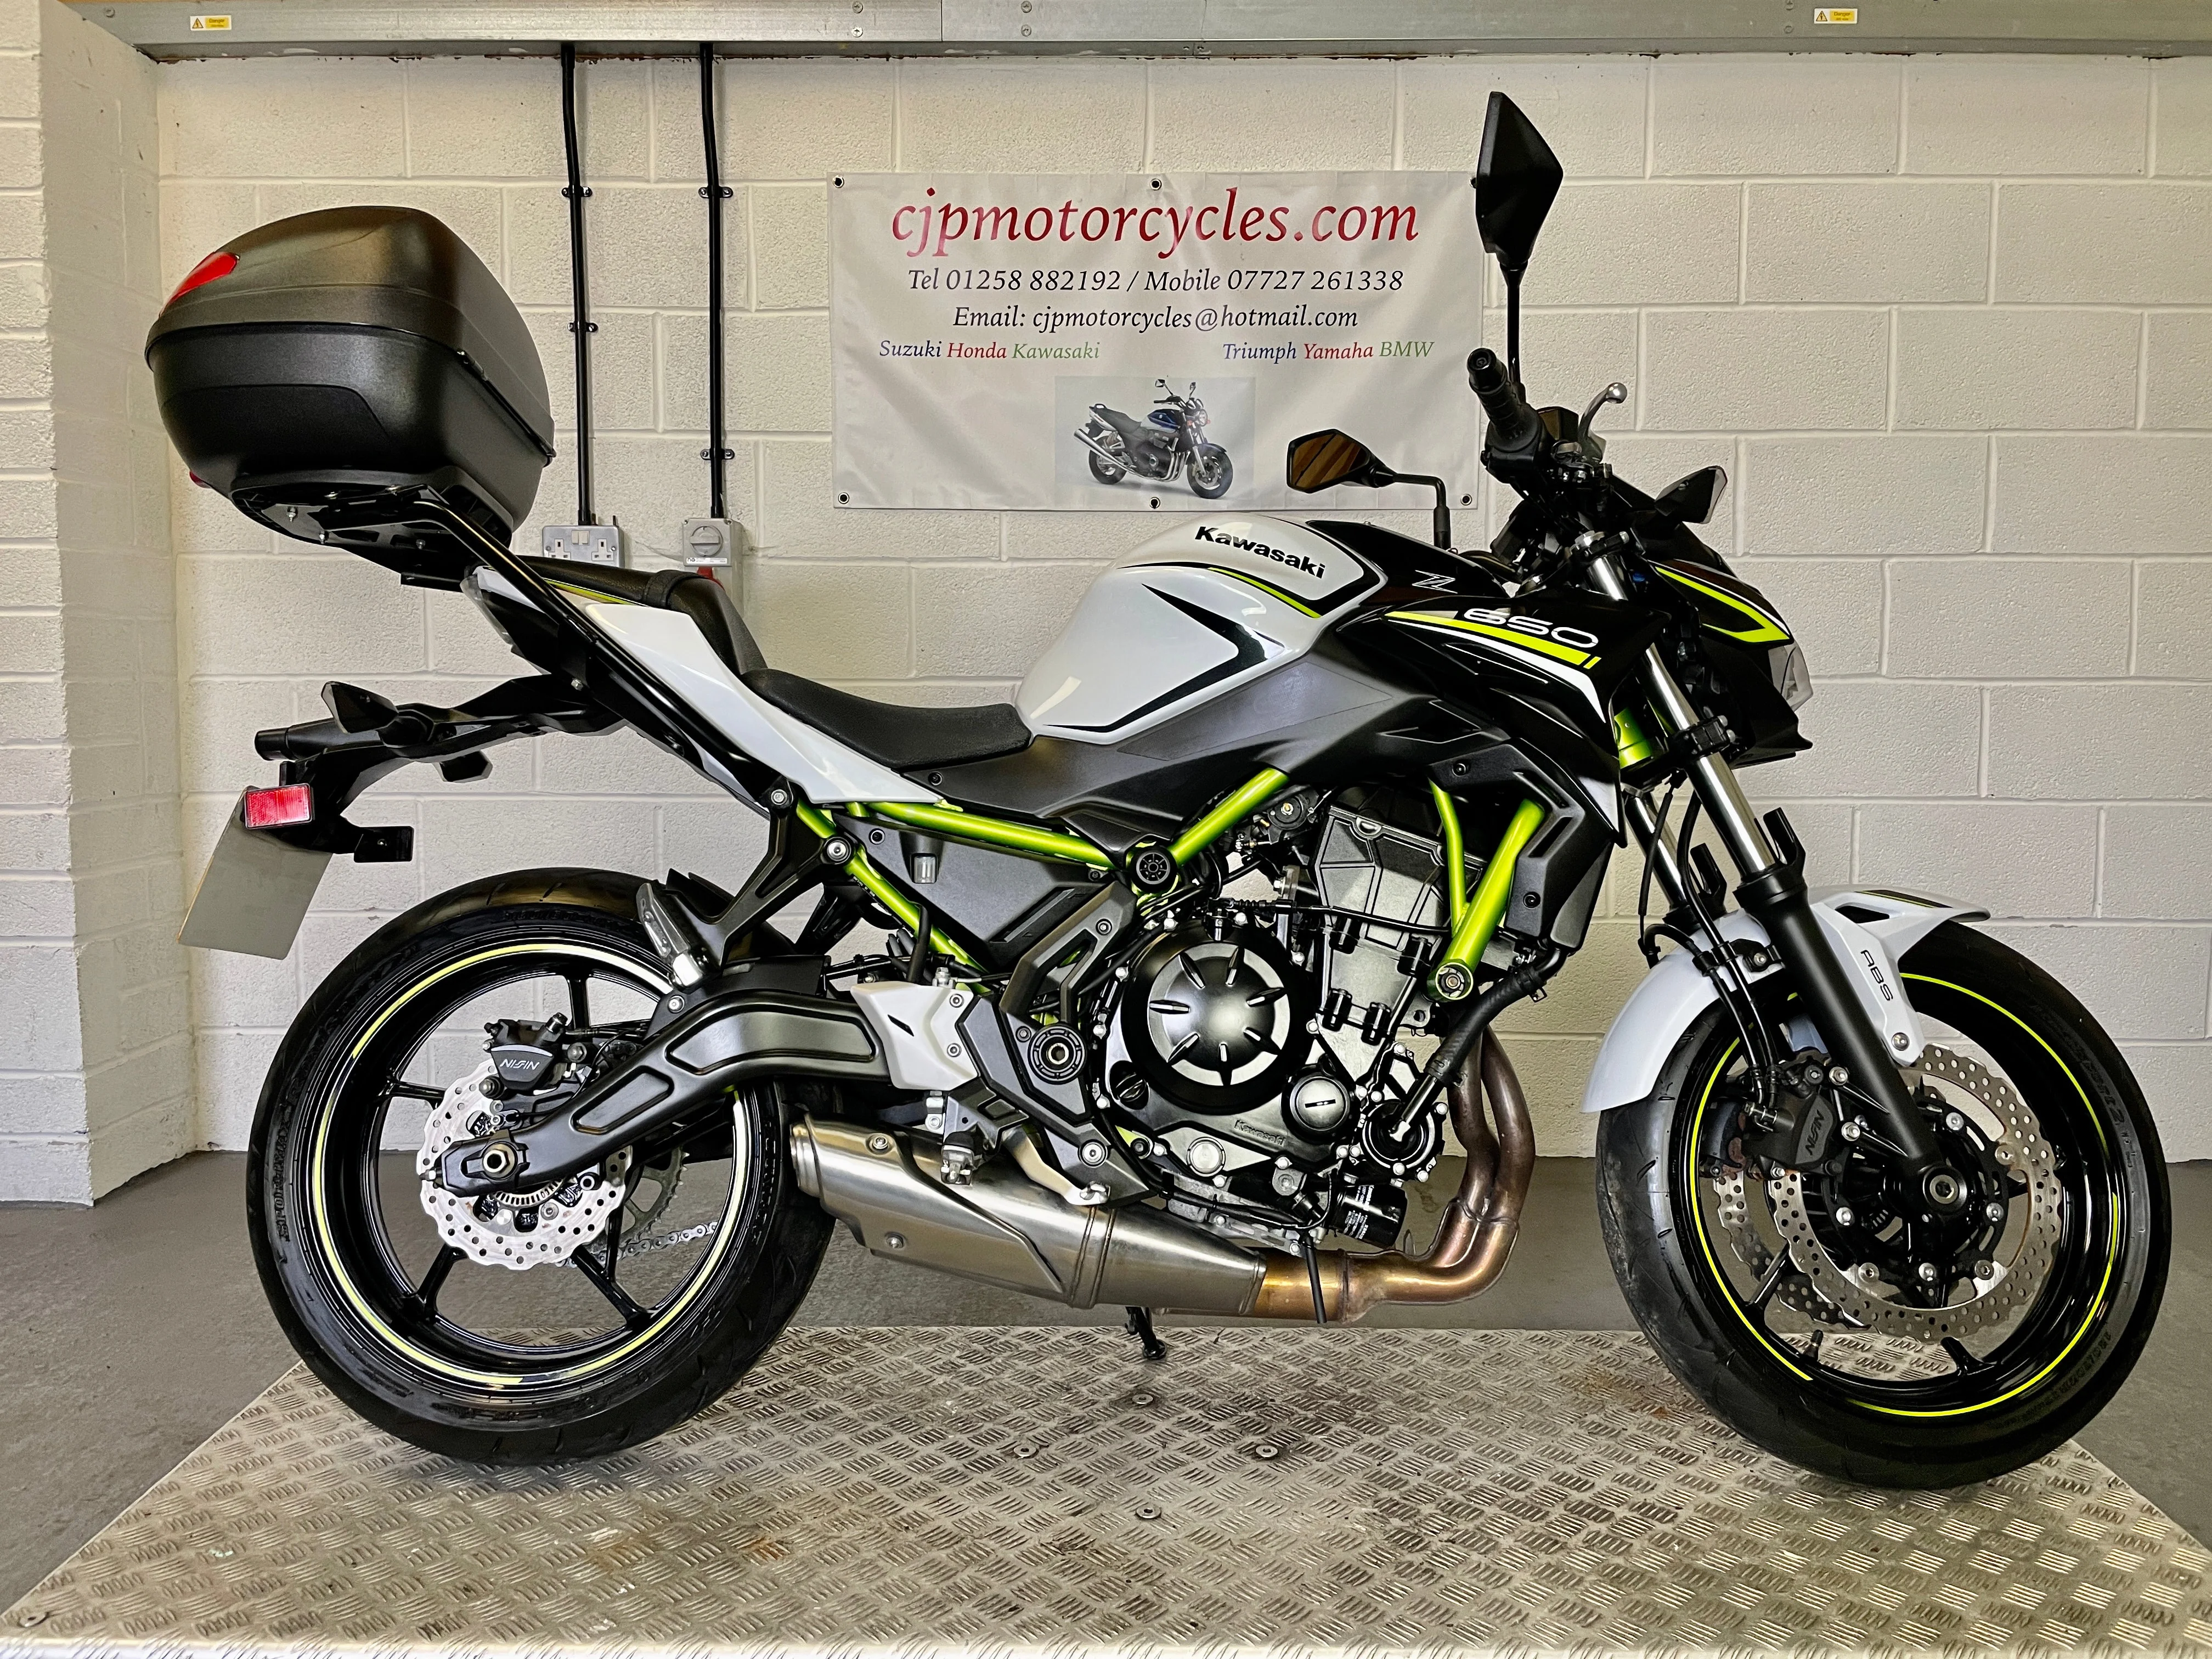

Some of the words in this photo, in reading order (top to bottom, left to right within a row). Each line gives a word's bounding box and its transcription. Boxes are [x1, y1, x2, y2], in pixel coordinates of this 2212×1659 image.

[892, 187, 1419, 259] cjpmotorcycles.com
[908, 268, 939, 290] Tel
[946, 269, 1022, 291] 01258
[1029, 270, 1120, 291] 882192
[1126, 270, 1139, 292] /
[1143, 268, 1221, 291] Mobile
[1228, 269, 1305, 290] 07727
[1311, 270, 1403, 291] 261338
[952, 306, 1026, 328] Email:
[1032, 304, 1358, 334] cjpmotorcycles@hotmail.com
[879, 340, 941, 358] Suzuki
[946, 342, 1007, 359] Honda
[1011, 341, 1099, 359] Kawasaki
[1222, 342, 1297, 365] Triumph
[1303, 341, 1374, 359] Yamaha
[1379, 341, 1435, 358] BMW
[1195, 525, 1326, 580] Kawasaki
[1464, 607, 1599, 648] 650
[1860, 950, 1893, 1001] ABS
[1233, 1120, 1287, 1147] Kawasaki
